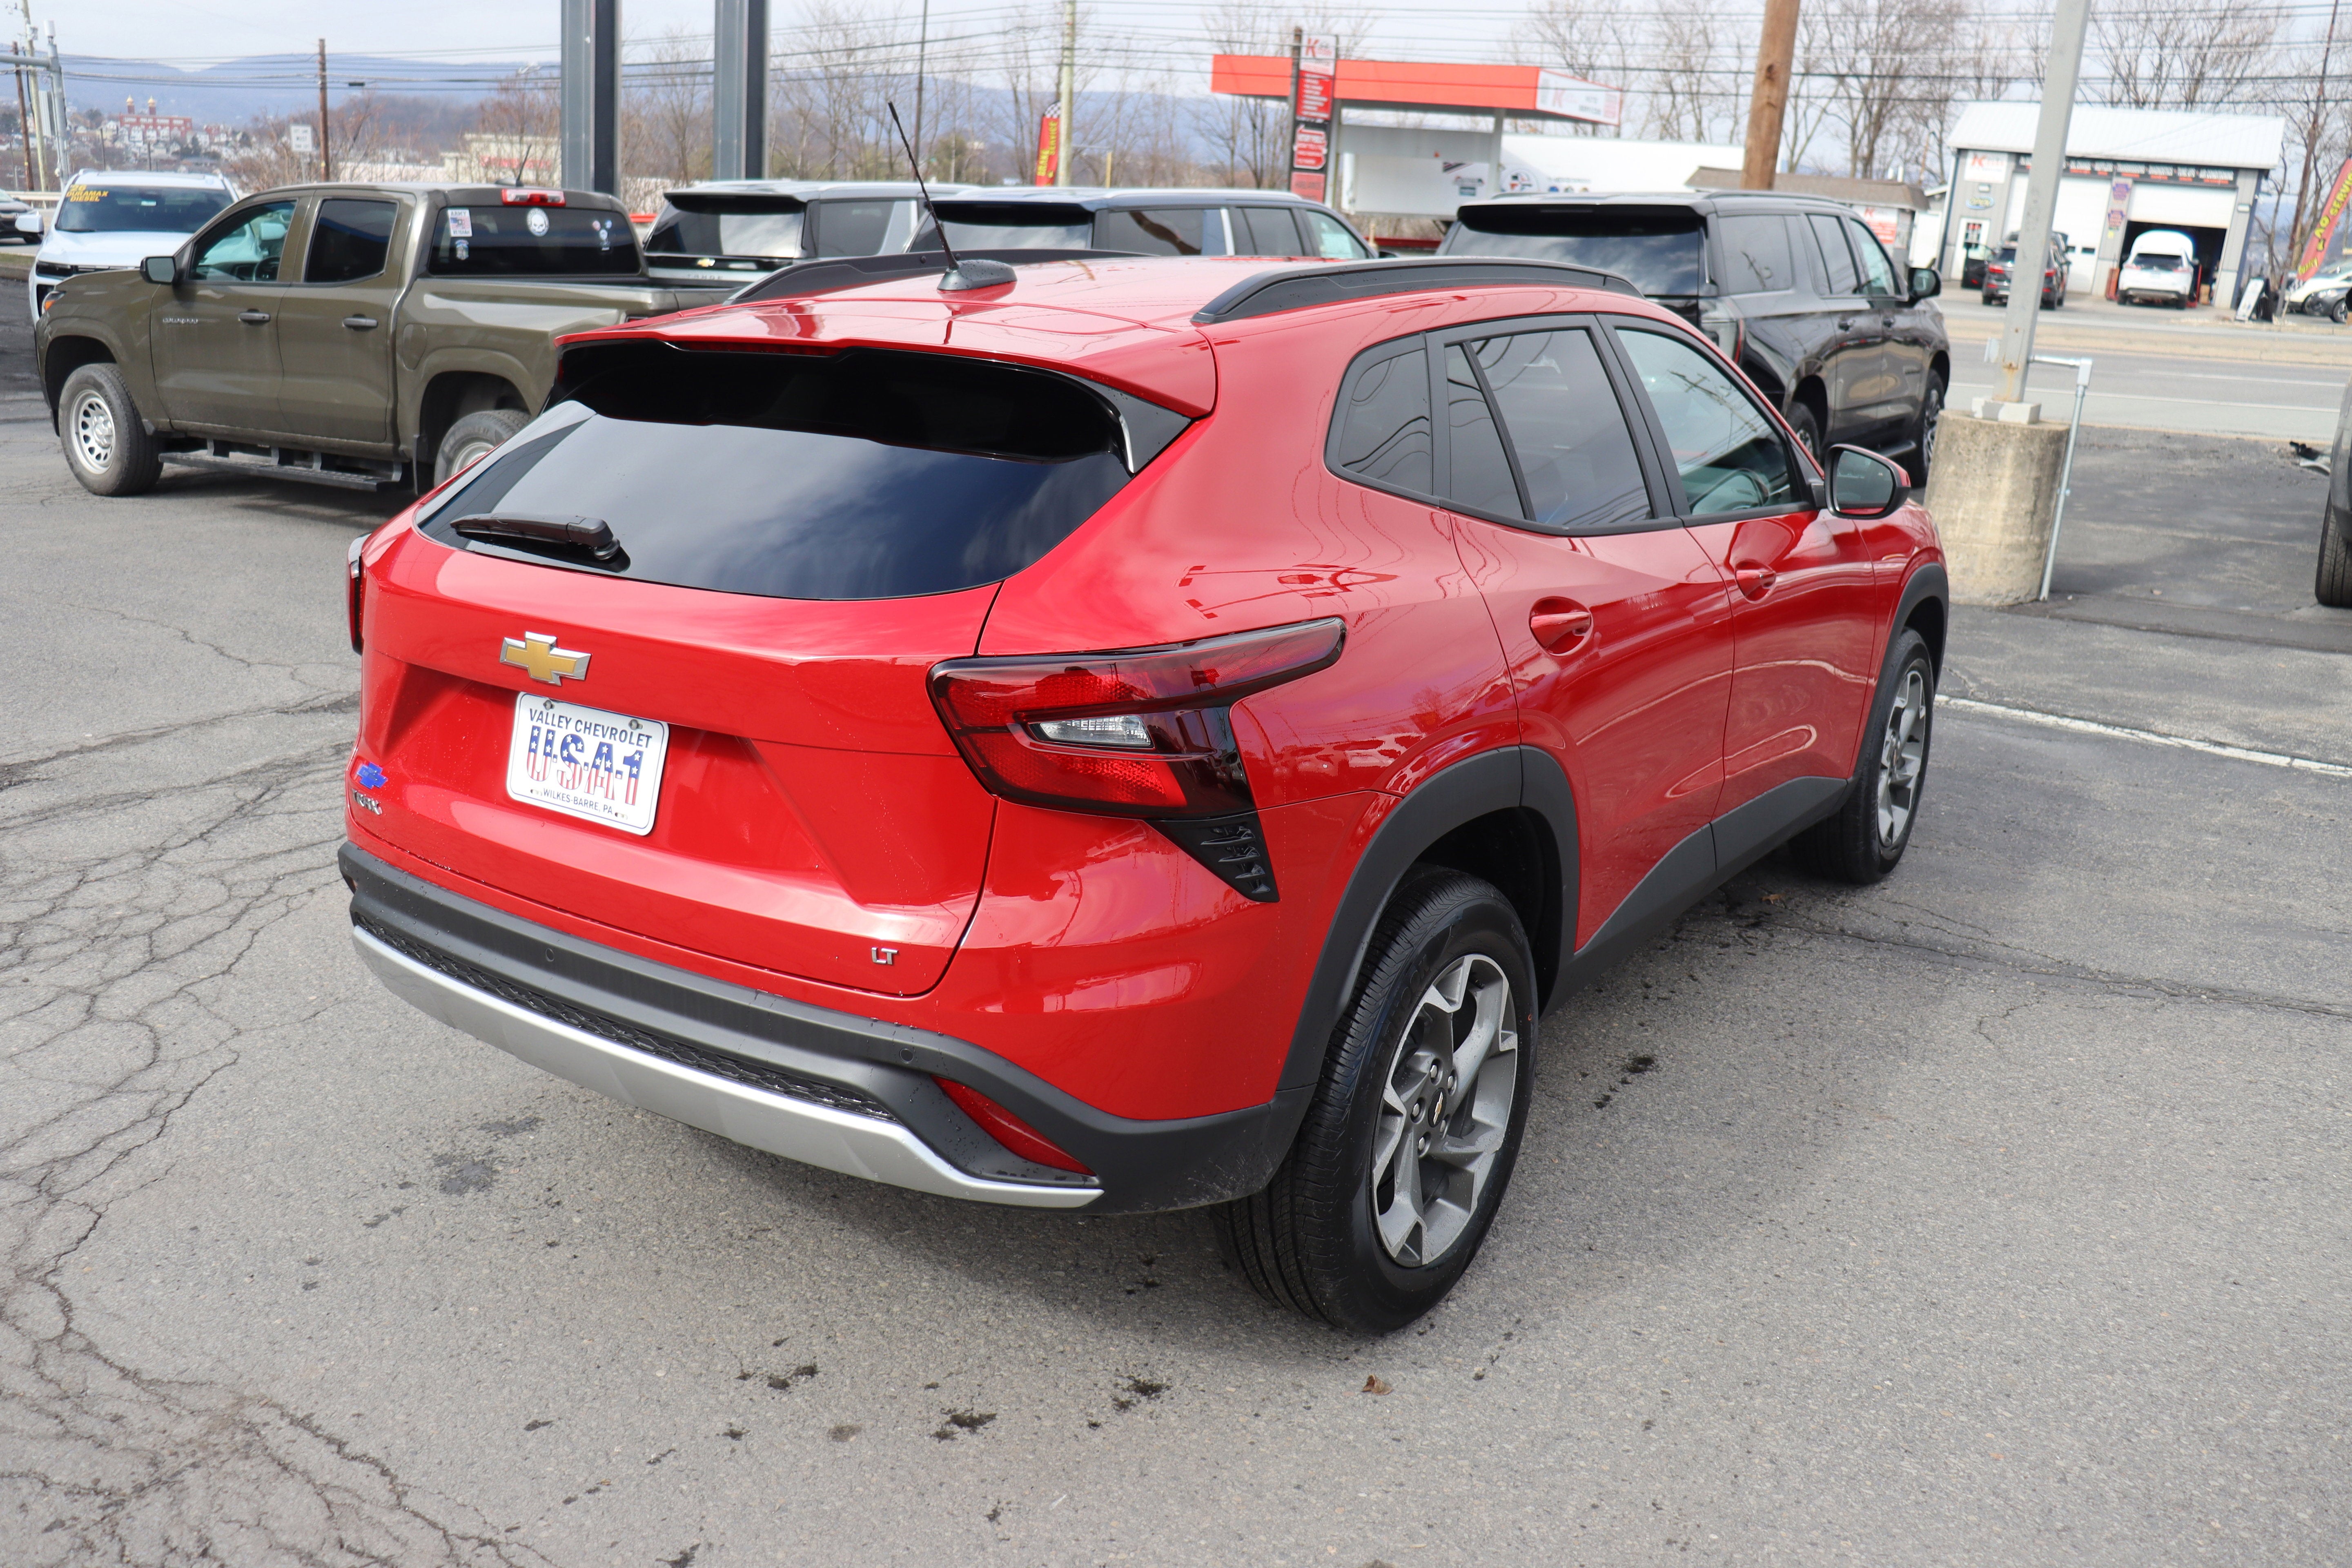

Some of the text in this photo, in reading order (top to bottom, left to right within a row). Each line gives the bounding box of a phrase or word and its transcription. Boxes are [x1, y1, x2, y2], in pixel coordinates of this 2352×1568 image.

[529, 708, 653, 748] VALLEY CHEVROLET
[543, 787, 613, 815] WILKES-BARRE, PA
[871, 947, 898, 965] LT
